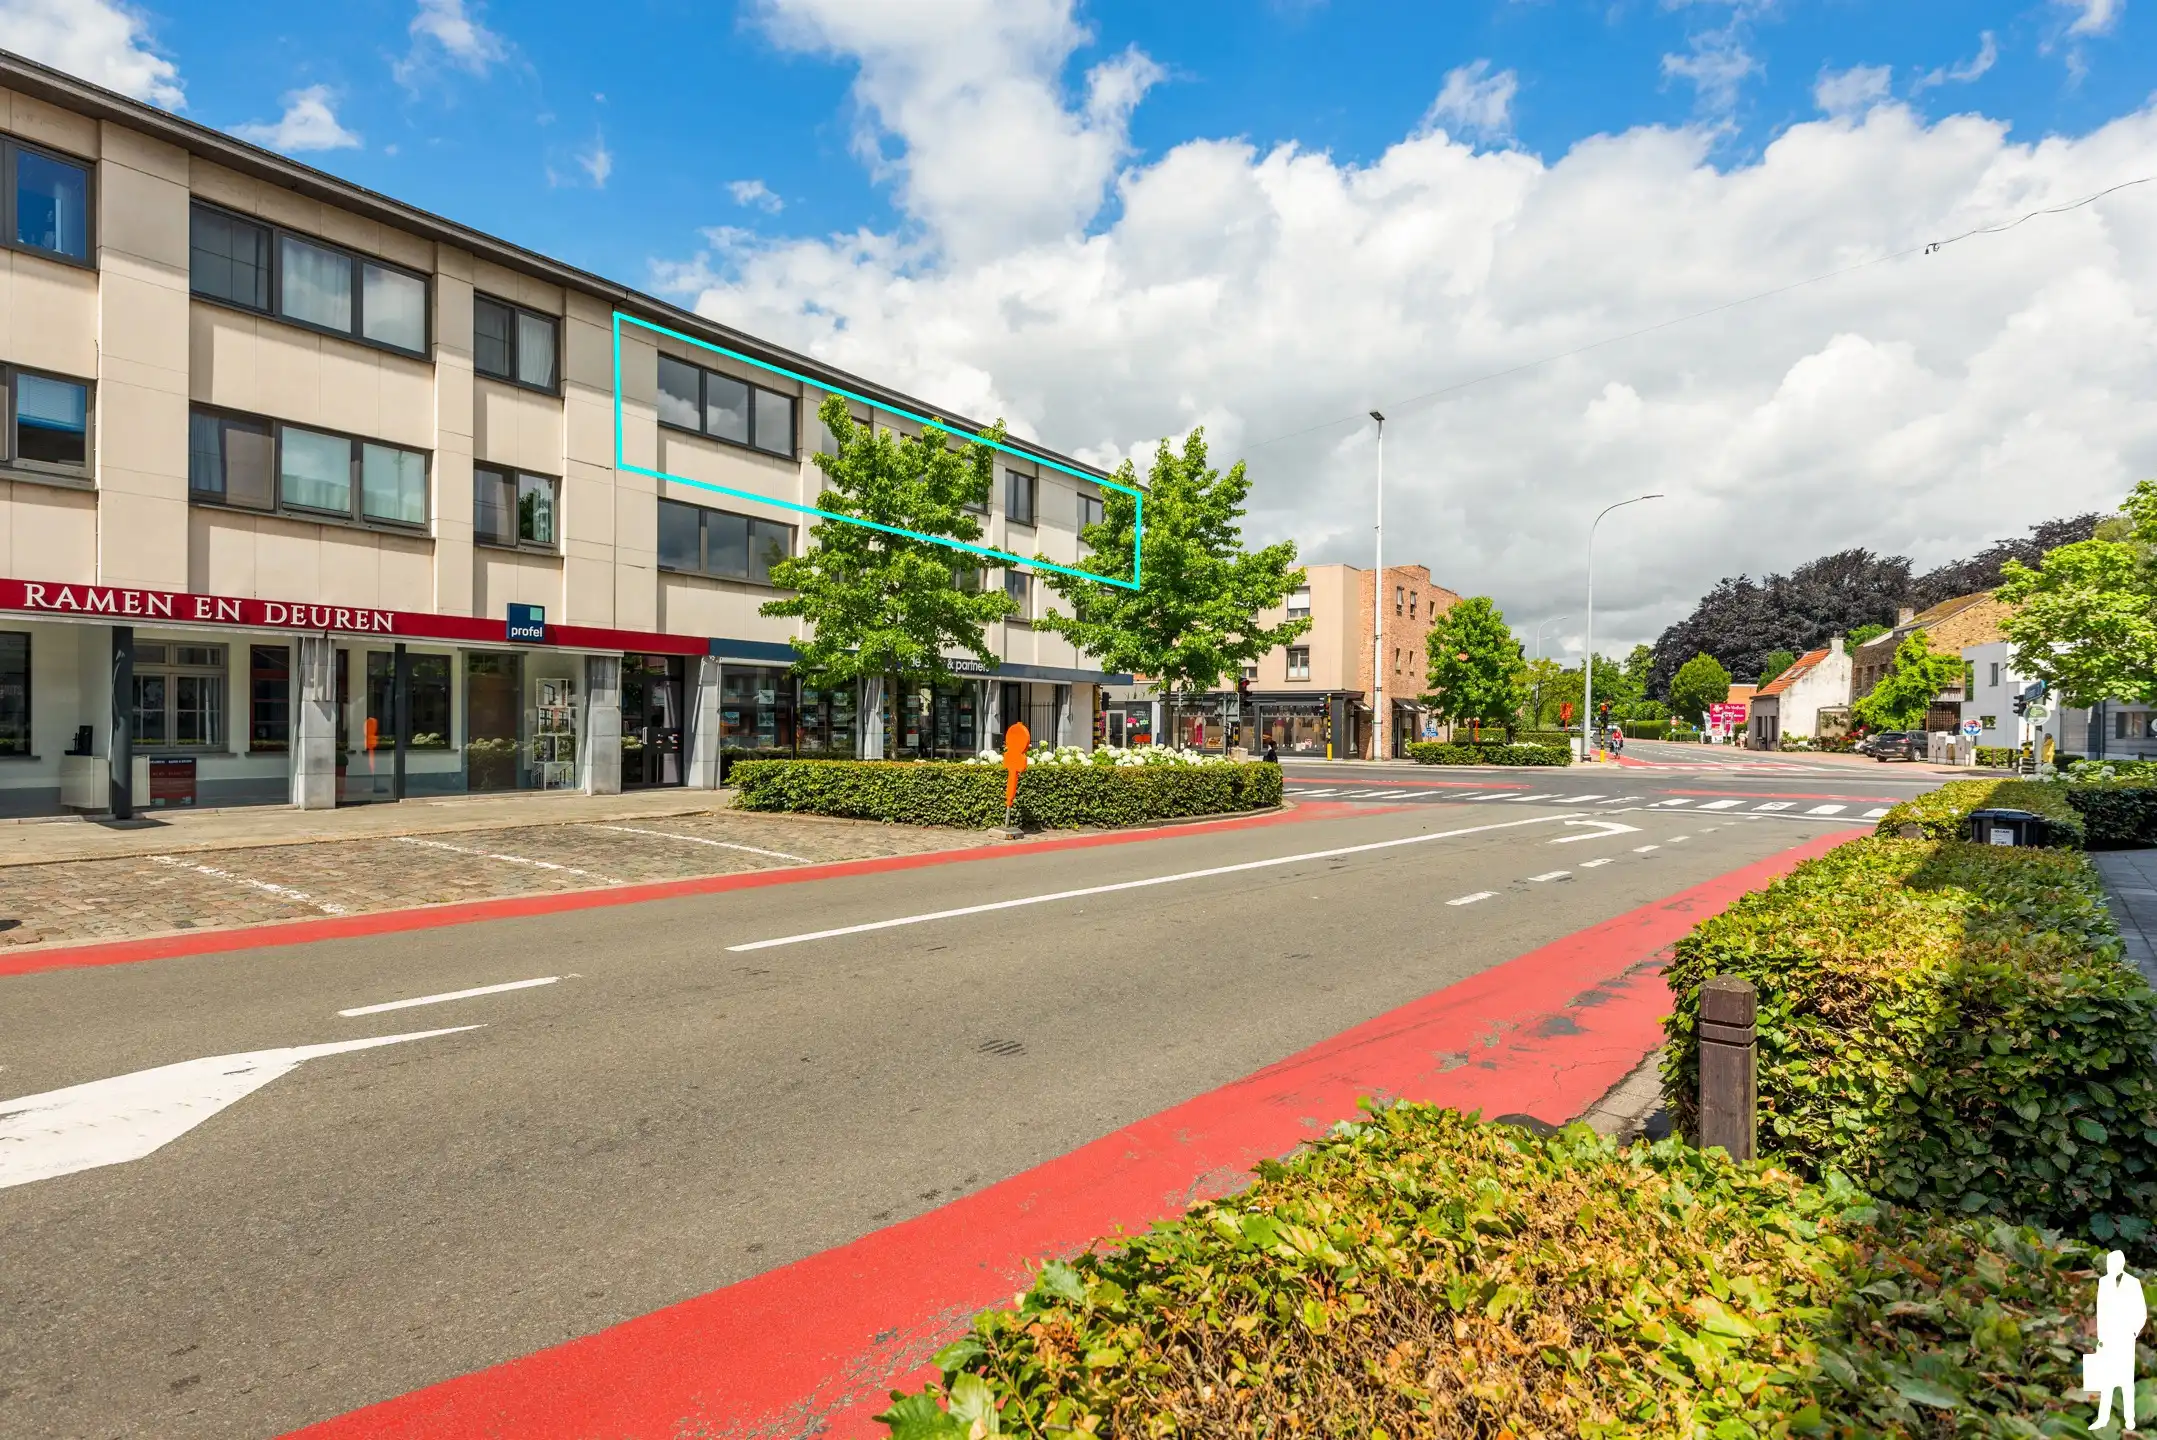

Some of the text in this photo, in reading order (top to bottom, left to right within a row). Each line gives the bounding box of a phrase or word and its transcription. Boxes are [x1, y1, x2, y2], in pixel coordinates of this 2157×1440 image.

[23, 583, 394, 632] RAMEN EN DEUREN
[511, 625, 543, 638] profel
[947, 657, 954, 670] &
